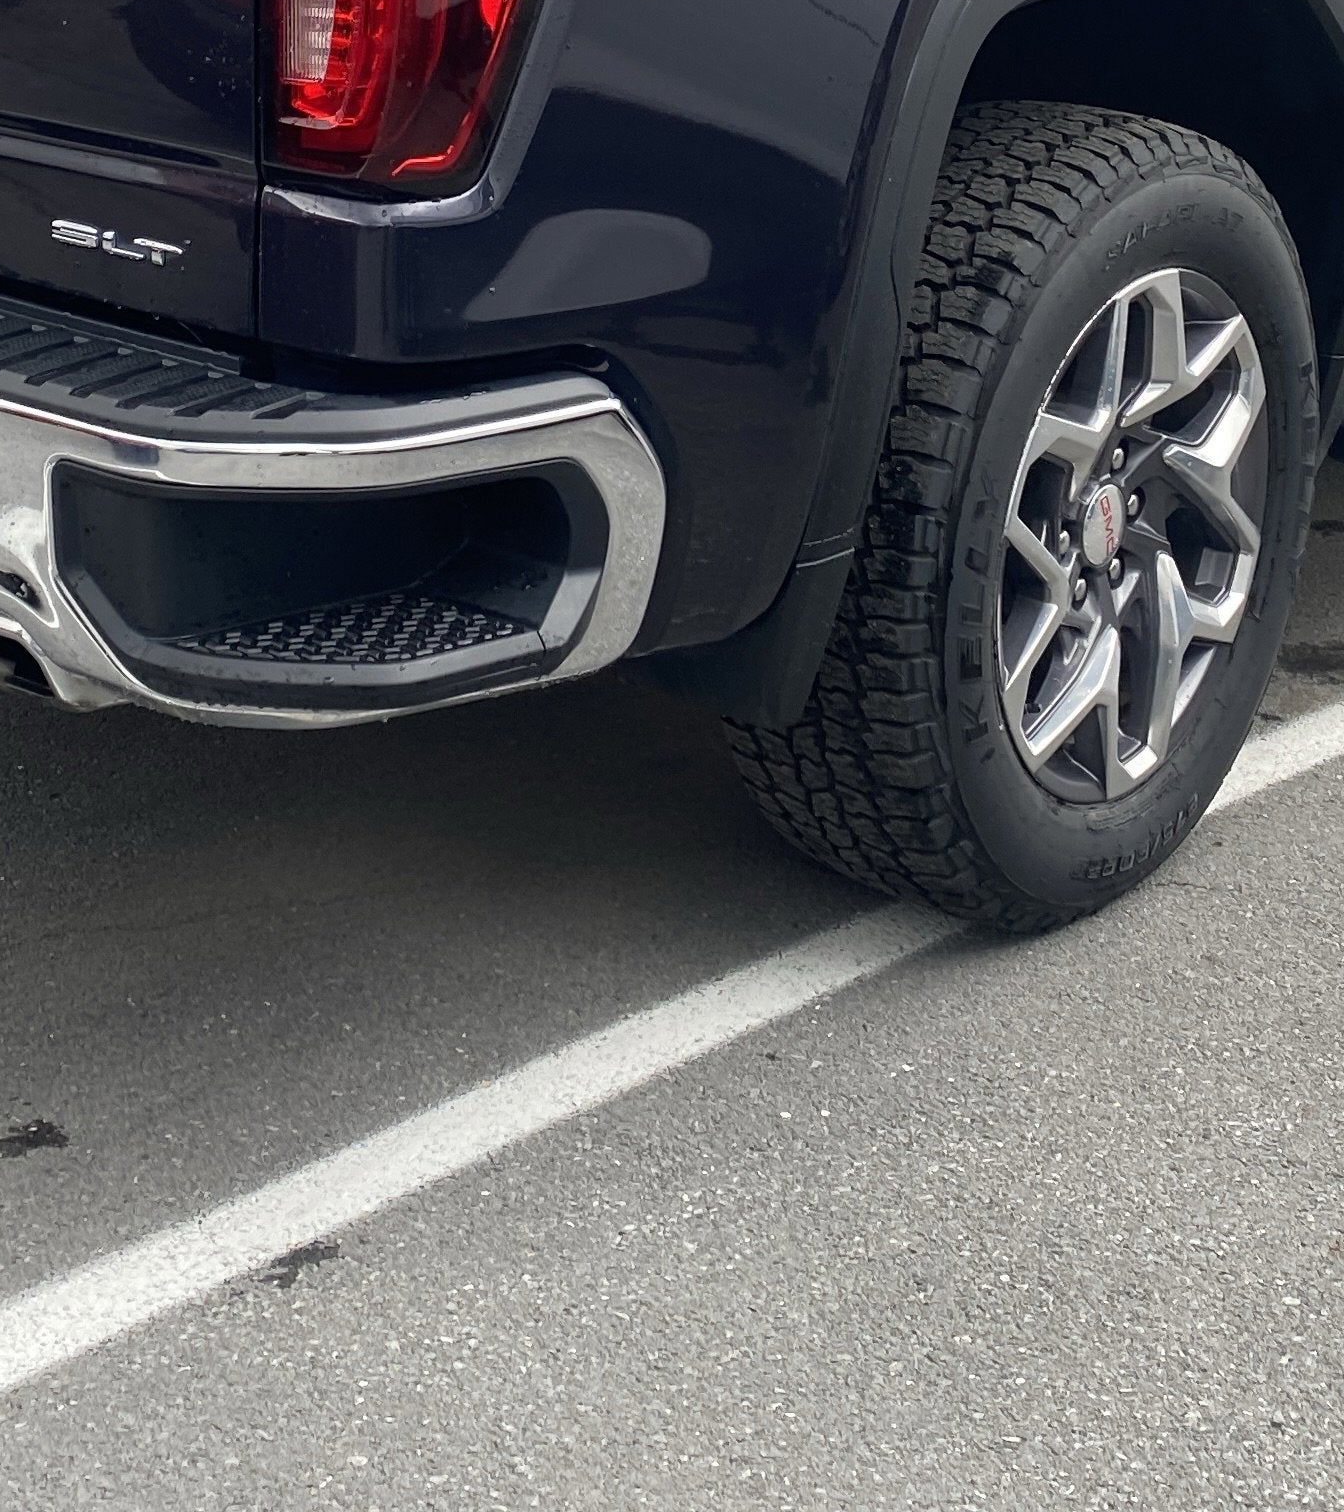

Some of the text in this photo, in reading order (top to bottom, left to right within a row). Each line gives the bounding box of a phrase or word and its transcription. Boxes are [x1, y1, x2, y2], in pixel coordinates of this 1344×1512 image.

[51, 218, 185, 267] SLT
[1100, 495, 1120, 557] GMC
[958, 467, 998, 744] KELLY
